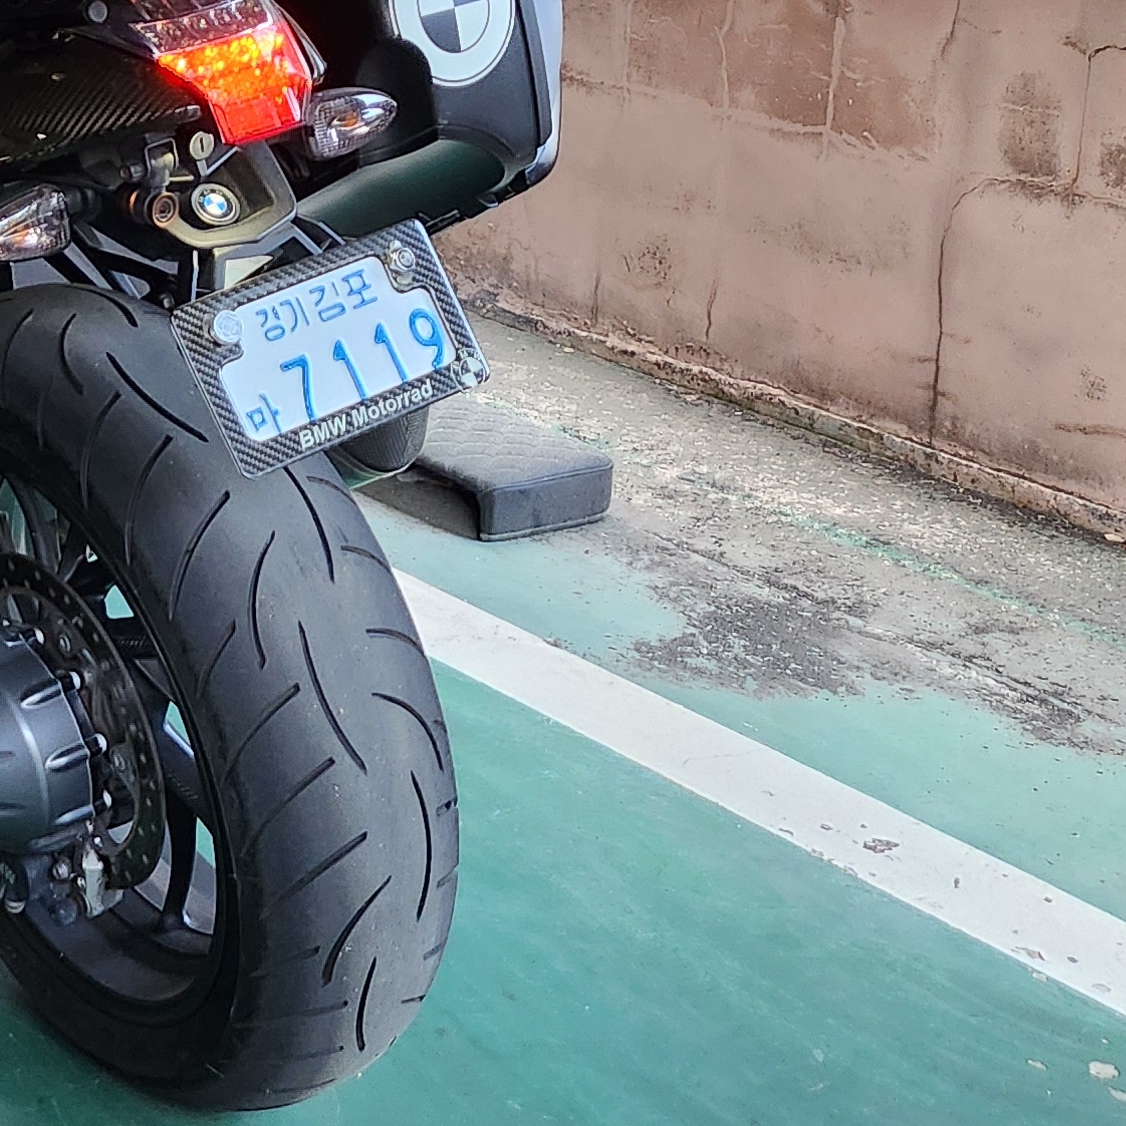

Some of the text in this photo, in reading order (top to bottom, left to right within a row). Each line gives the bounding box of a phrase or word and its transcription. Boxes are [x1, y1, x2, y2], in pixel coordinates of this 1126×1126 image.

[246, 308, 446, 435] 마 7119
[299, 380, 434, 451] BMW Motorrad
